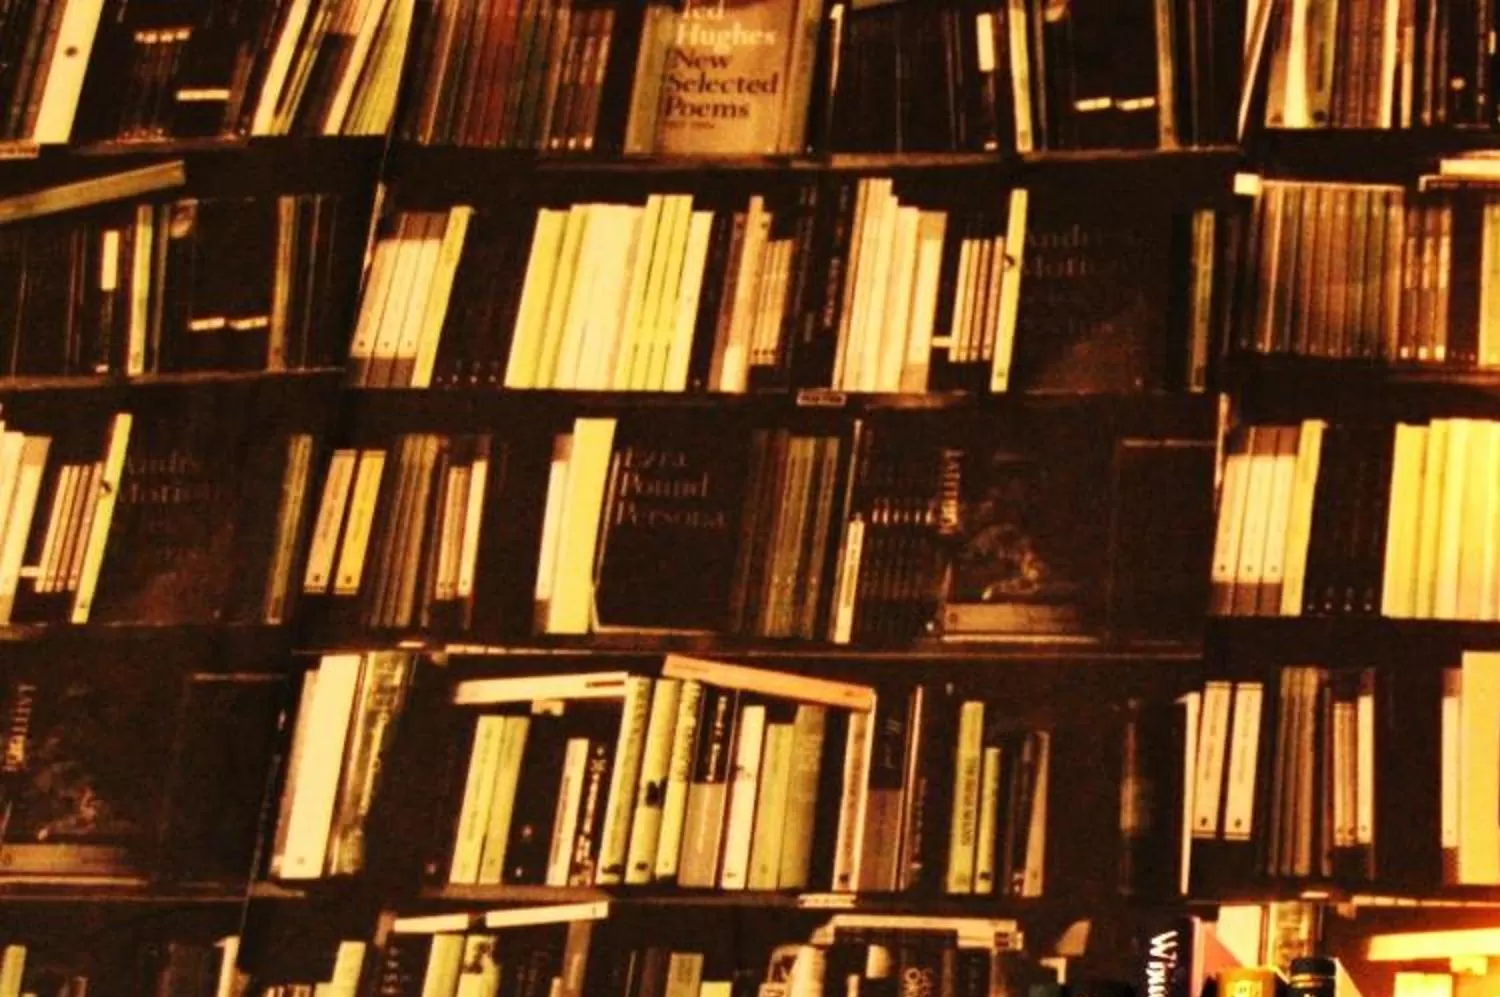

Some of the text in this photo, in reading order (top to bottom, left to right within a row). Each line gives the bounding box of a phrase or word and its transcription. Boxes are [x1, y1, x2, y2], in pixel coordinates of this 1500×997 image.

[676, 22, 777, 54] Hughes
[674, 49, 732, 71] New
[667, 72, 780, 95] Selected
[665, 97, 750, 119] Poems
